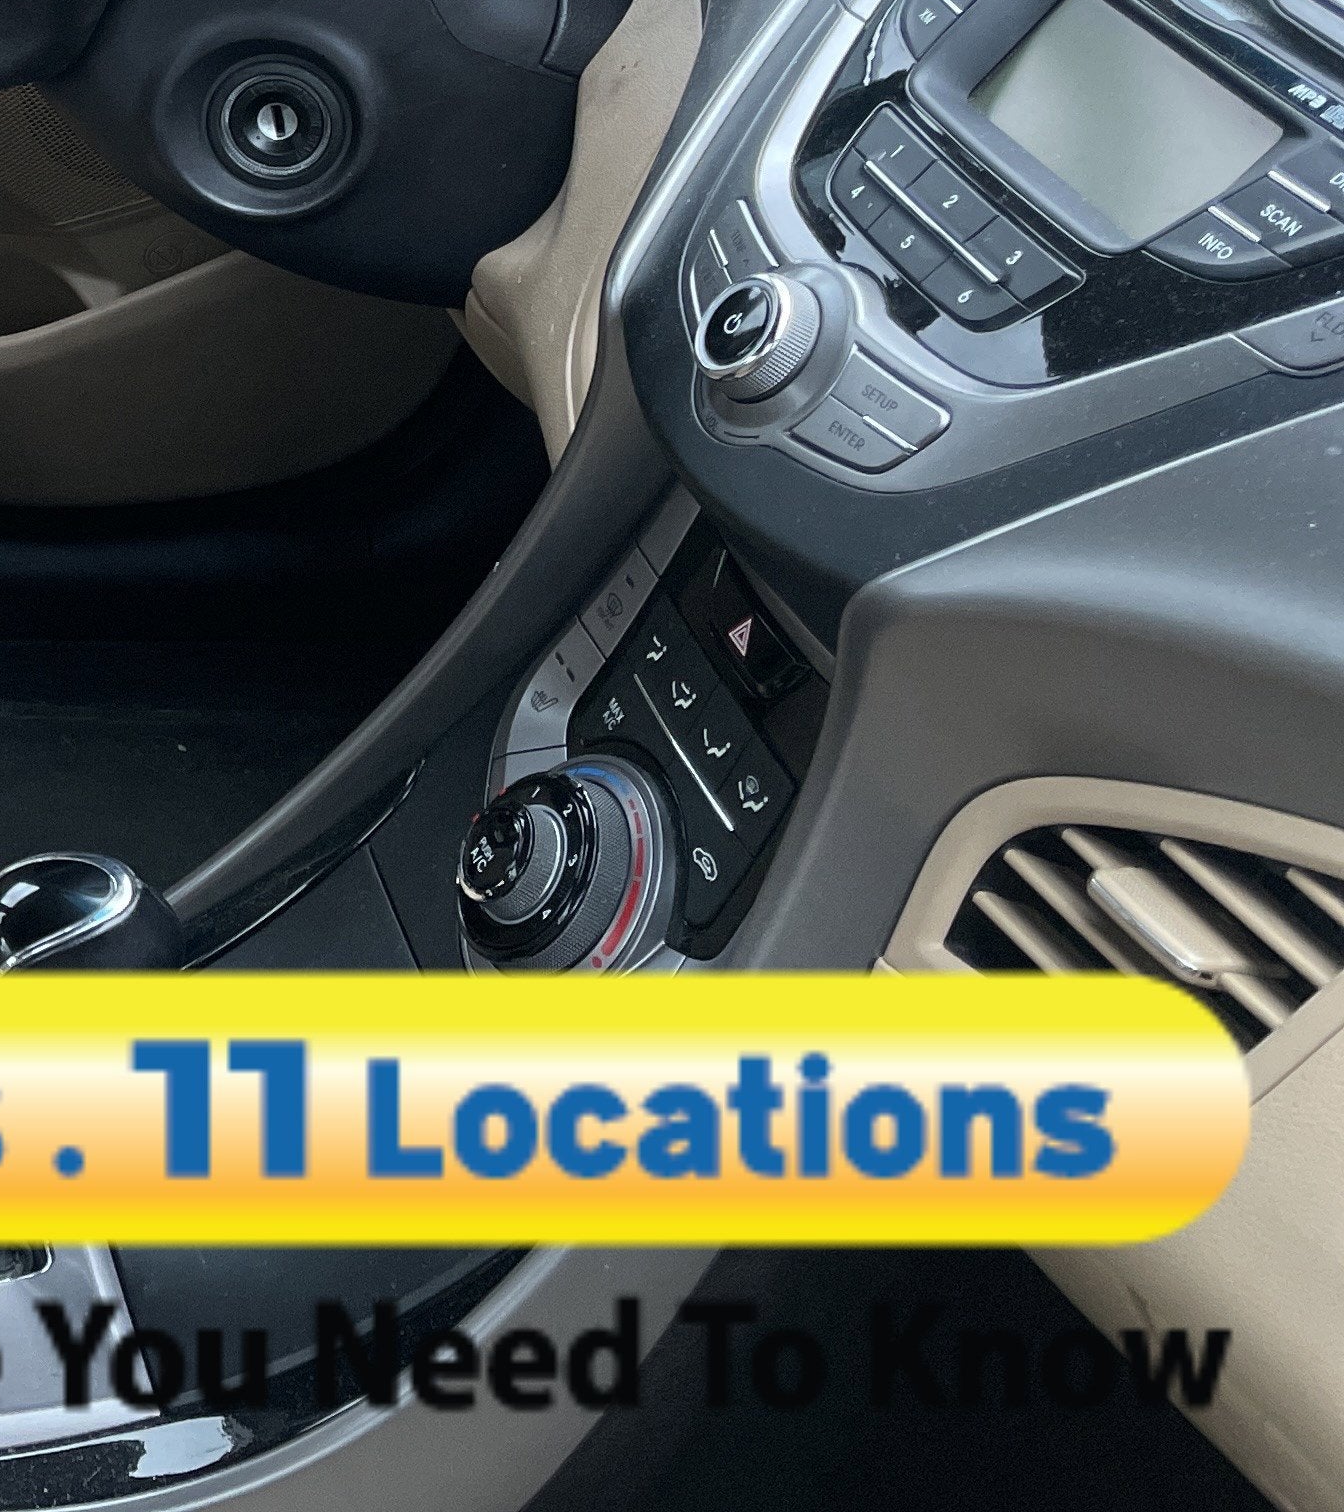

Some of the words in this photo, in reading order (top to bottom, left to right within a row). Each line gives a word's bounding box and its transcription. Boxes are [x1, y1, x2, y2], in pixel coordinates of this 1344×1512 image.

[918, 8, 937, 25] XM
[1288, 83, 1327, 109] MP3
[850, 185, 865, 199] 4
[942, 195, 959, 209] 2
[1260, 204, 1302, 237] SCAN
[900, 235, 915, 249] 5
[1198, 232, 1233, 260] INFO
[1005, 250, 1023, 265] 3
[957, 289, 975, 303] 6
[862, 385, 899, 411] SETUP
[828, 421, 866, 452] ENTER
[563, 803, 574, 817] 2
[470, 847, 487, 873] A/C
[568, 854, 579, 867] 3
[542, 909, 552, 920] 4
